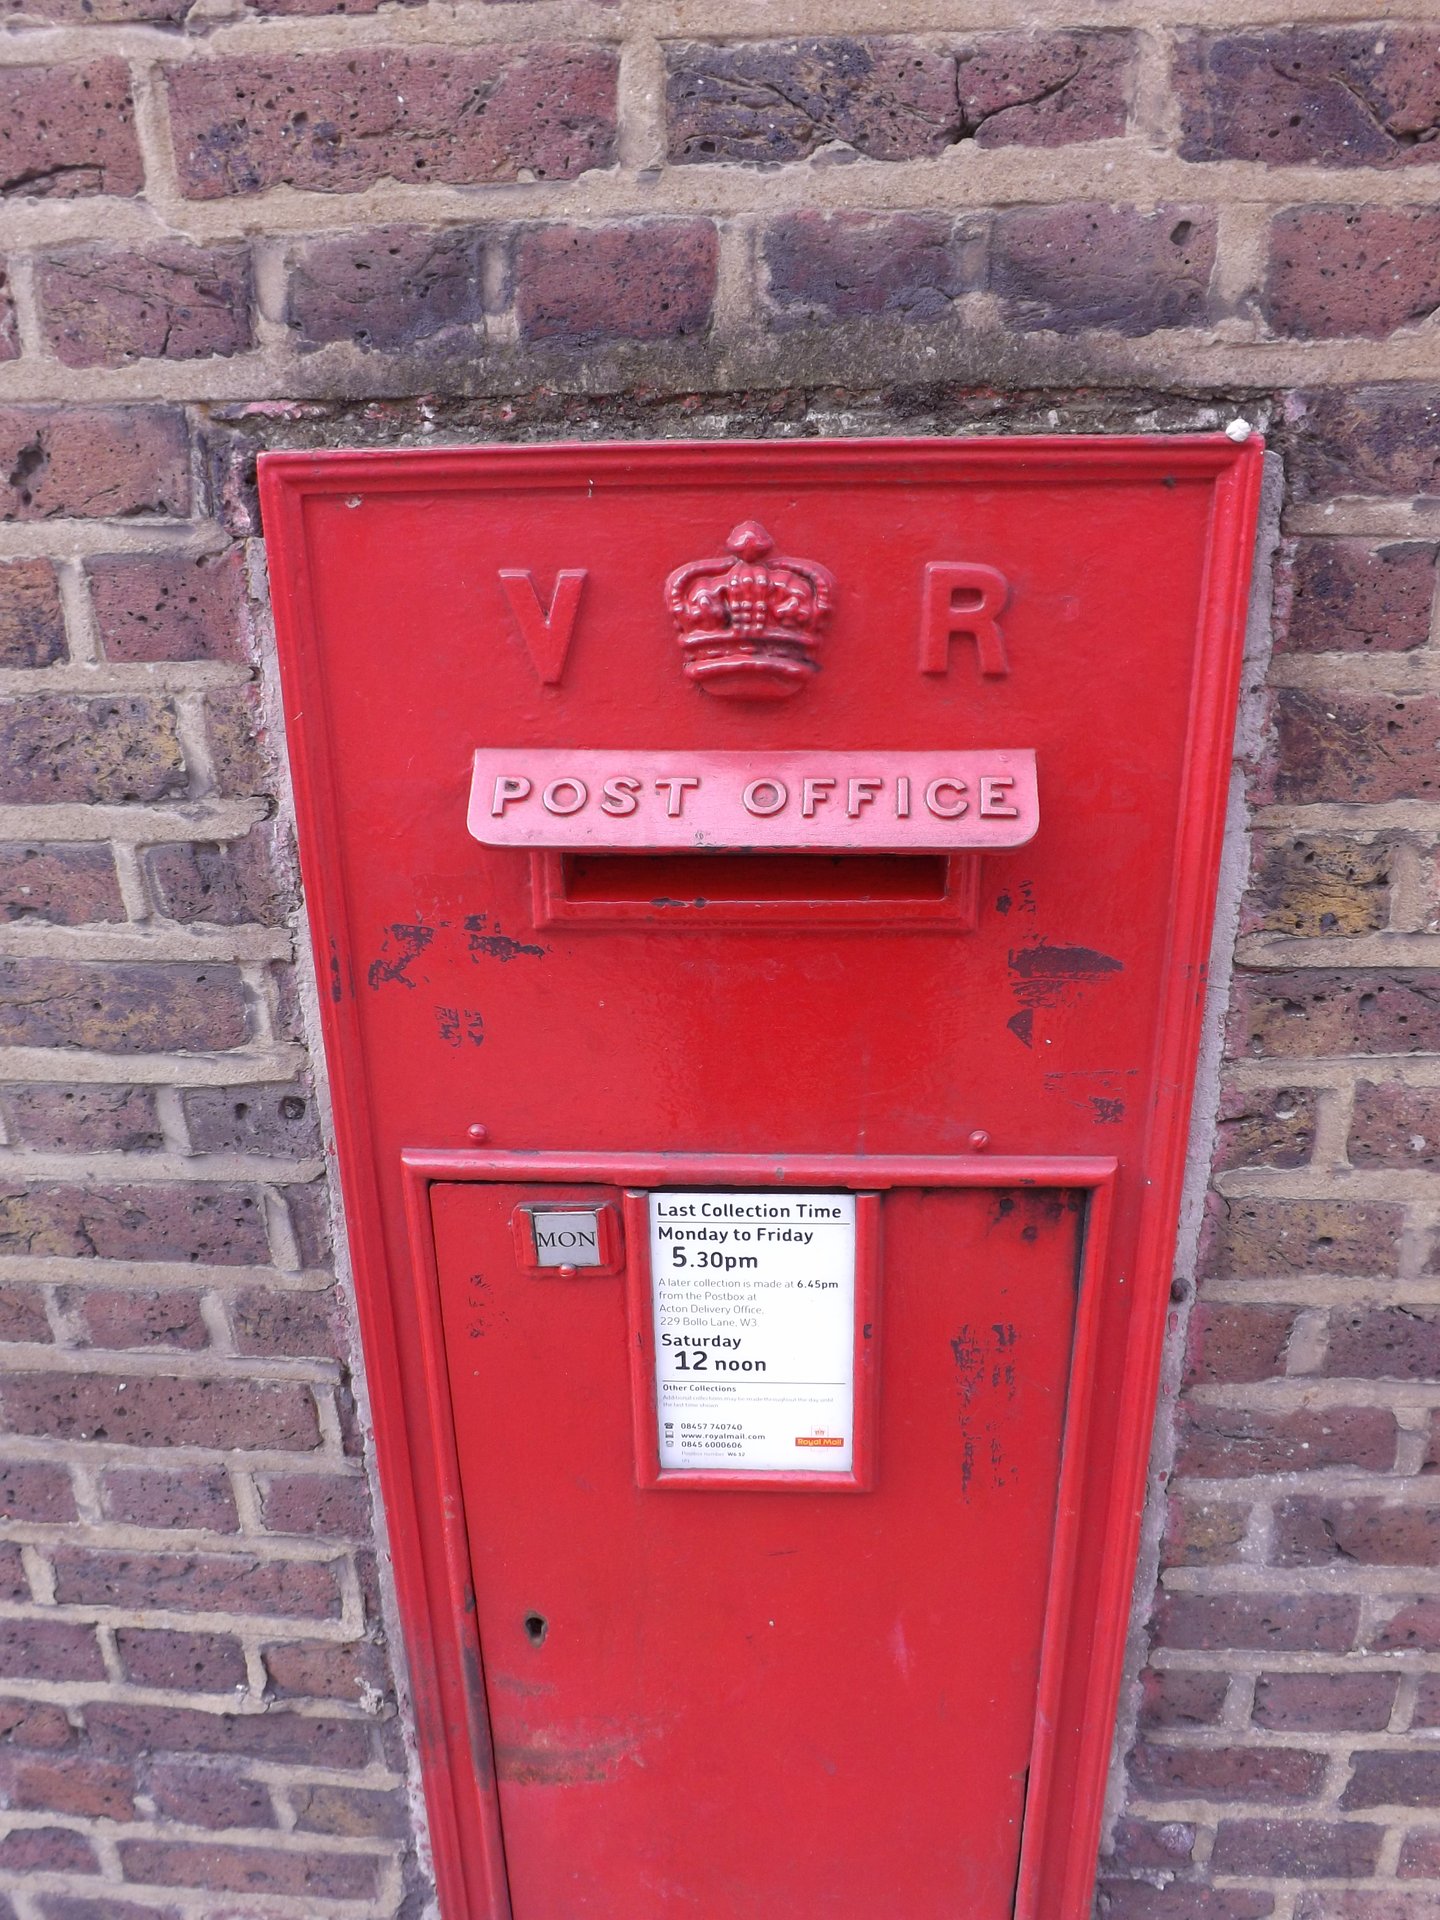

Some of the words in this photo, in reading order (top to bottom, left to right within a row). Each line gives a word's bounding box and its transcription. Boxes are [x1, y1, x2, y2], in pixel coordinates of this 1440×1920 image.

[498, 568, 589, 685] V
[919, 561, 1010, 676] R
[490, 775, 699, 819] POST
[742, 776, 1019, 819] OFFICE
[657, 1203, 696, 1217] Last
[701, 1203, 790, 1218] Collection
[796, 1204, 842, 1218] Time
[537, 1232, 596, 1247] MON
[658, 1227, 728, 1243] Monday
[734, 1229, 751, 1241] to
[757, 1228, 813, 1245] Friday
[672, 1246, 758, 1272] 5.30pm
[658, 1278, 666, 1287] A
[668, 1279, 691, 1288] later
[694, 1279, 741, 1288] collection
[754, 1280, 782, 1288] made
[797, 1280, 839, 1290] 6.45pm
[659, 1291, 684, 1300] from
[686, 1291, 702, 1300] the
[705, 1292, 745, 1301] Postbox
[747, 1293, 757, 1301] at
[660, 1304, 688, 1313] Acton
[691, 1305, 731, 1315] Delivery
[660, 1317, 680, 1326] 229
[683, 1317, 708, 1326] Bollo
[662, 1334, 742, 1350] Saturday
[674, 1351, 708, 1371] 12
[715, 1360, 766, 1371] noon
